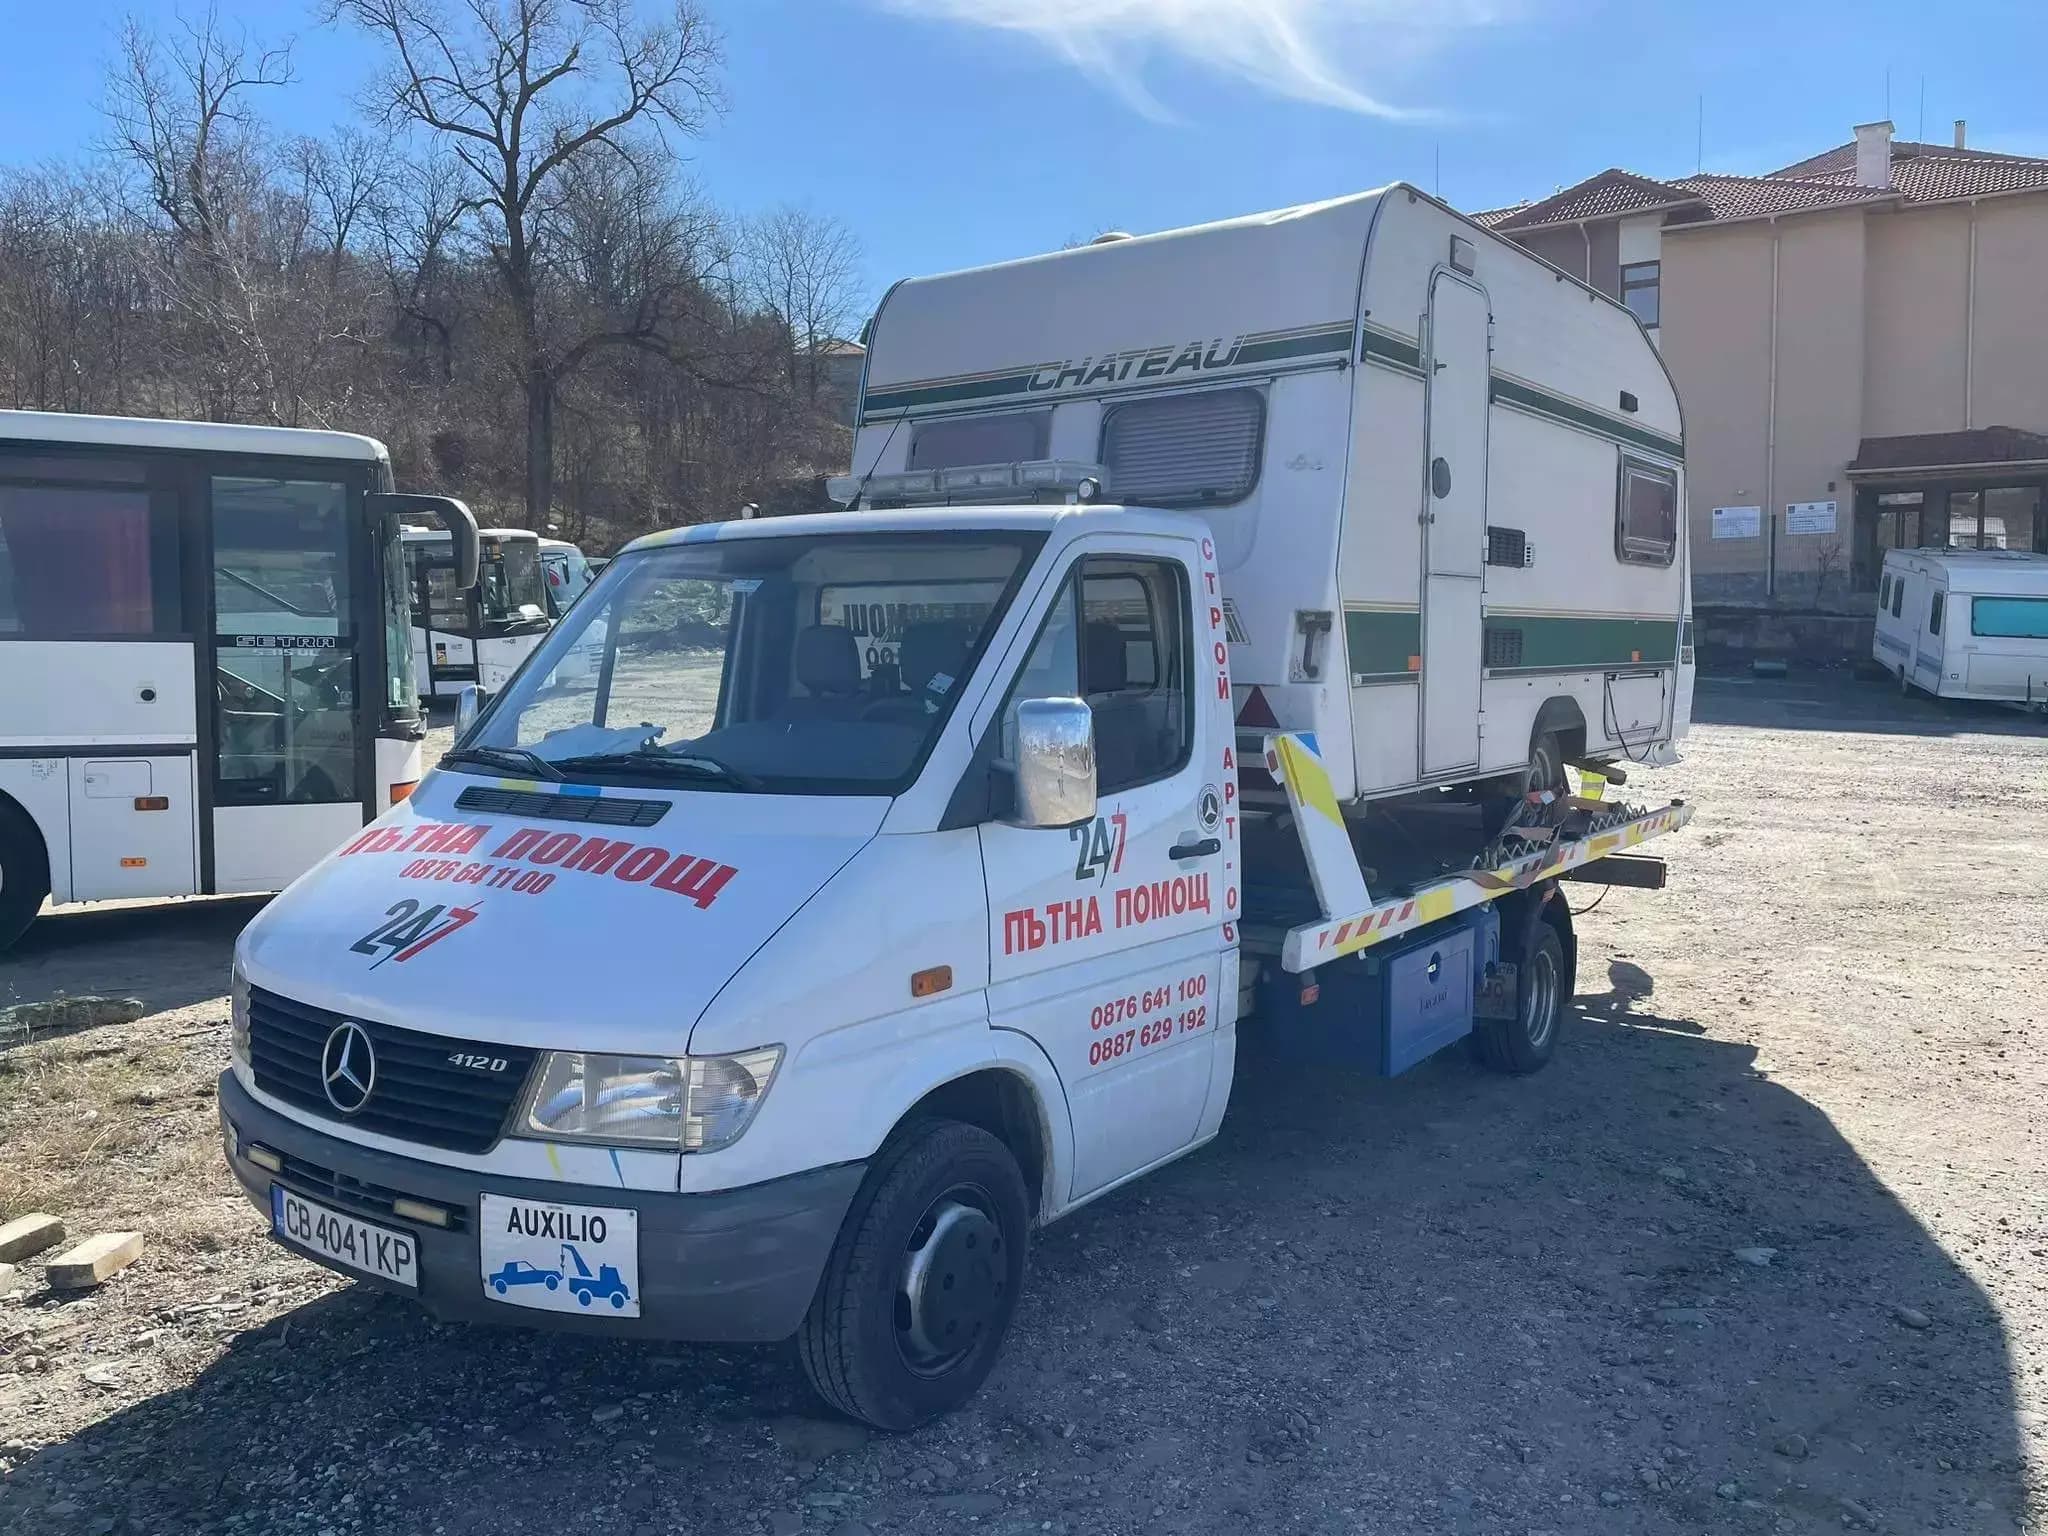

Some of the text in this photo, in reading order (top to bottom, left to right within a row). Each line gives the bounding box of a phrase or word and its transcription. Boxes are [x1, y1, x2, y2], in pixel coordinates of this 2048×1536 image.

[1028, 336, 1245, 391] CHATEAU
[236, 635, 335, 648] SETRA
[1201, 537, 1229, 699] СТРОЙ
[339, 824, 739, 909] ПЪТНА ПОМОЩ
[399, 858, 461, 881] 0876
[1005, 872, 1210, 955] ПЪТНА ПОМОЩ
[1091, 974, 1206, 1030] 0876 641 100
[1089, 1006, 1206, 1065] 0887 629 192
[316, 1214, 369, 1265] 4041
[507, 1207, 607, 1243] AUXILIO
